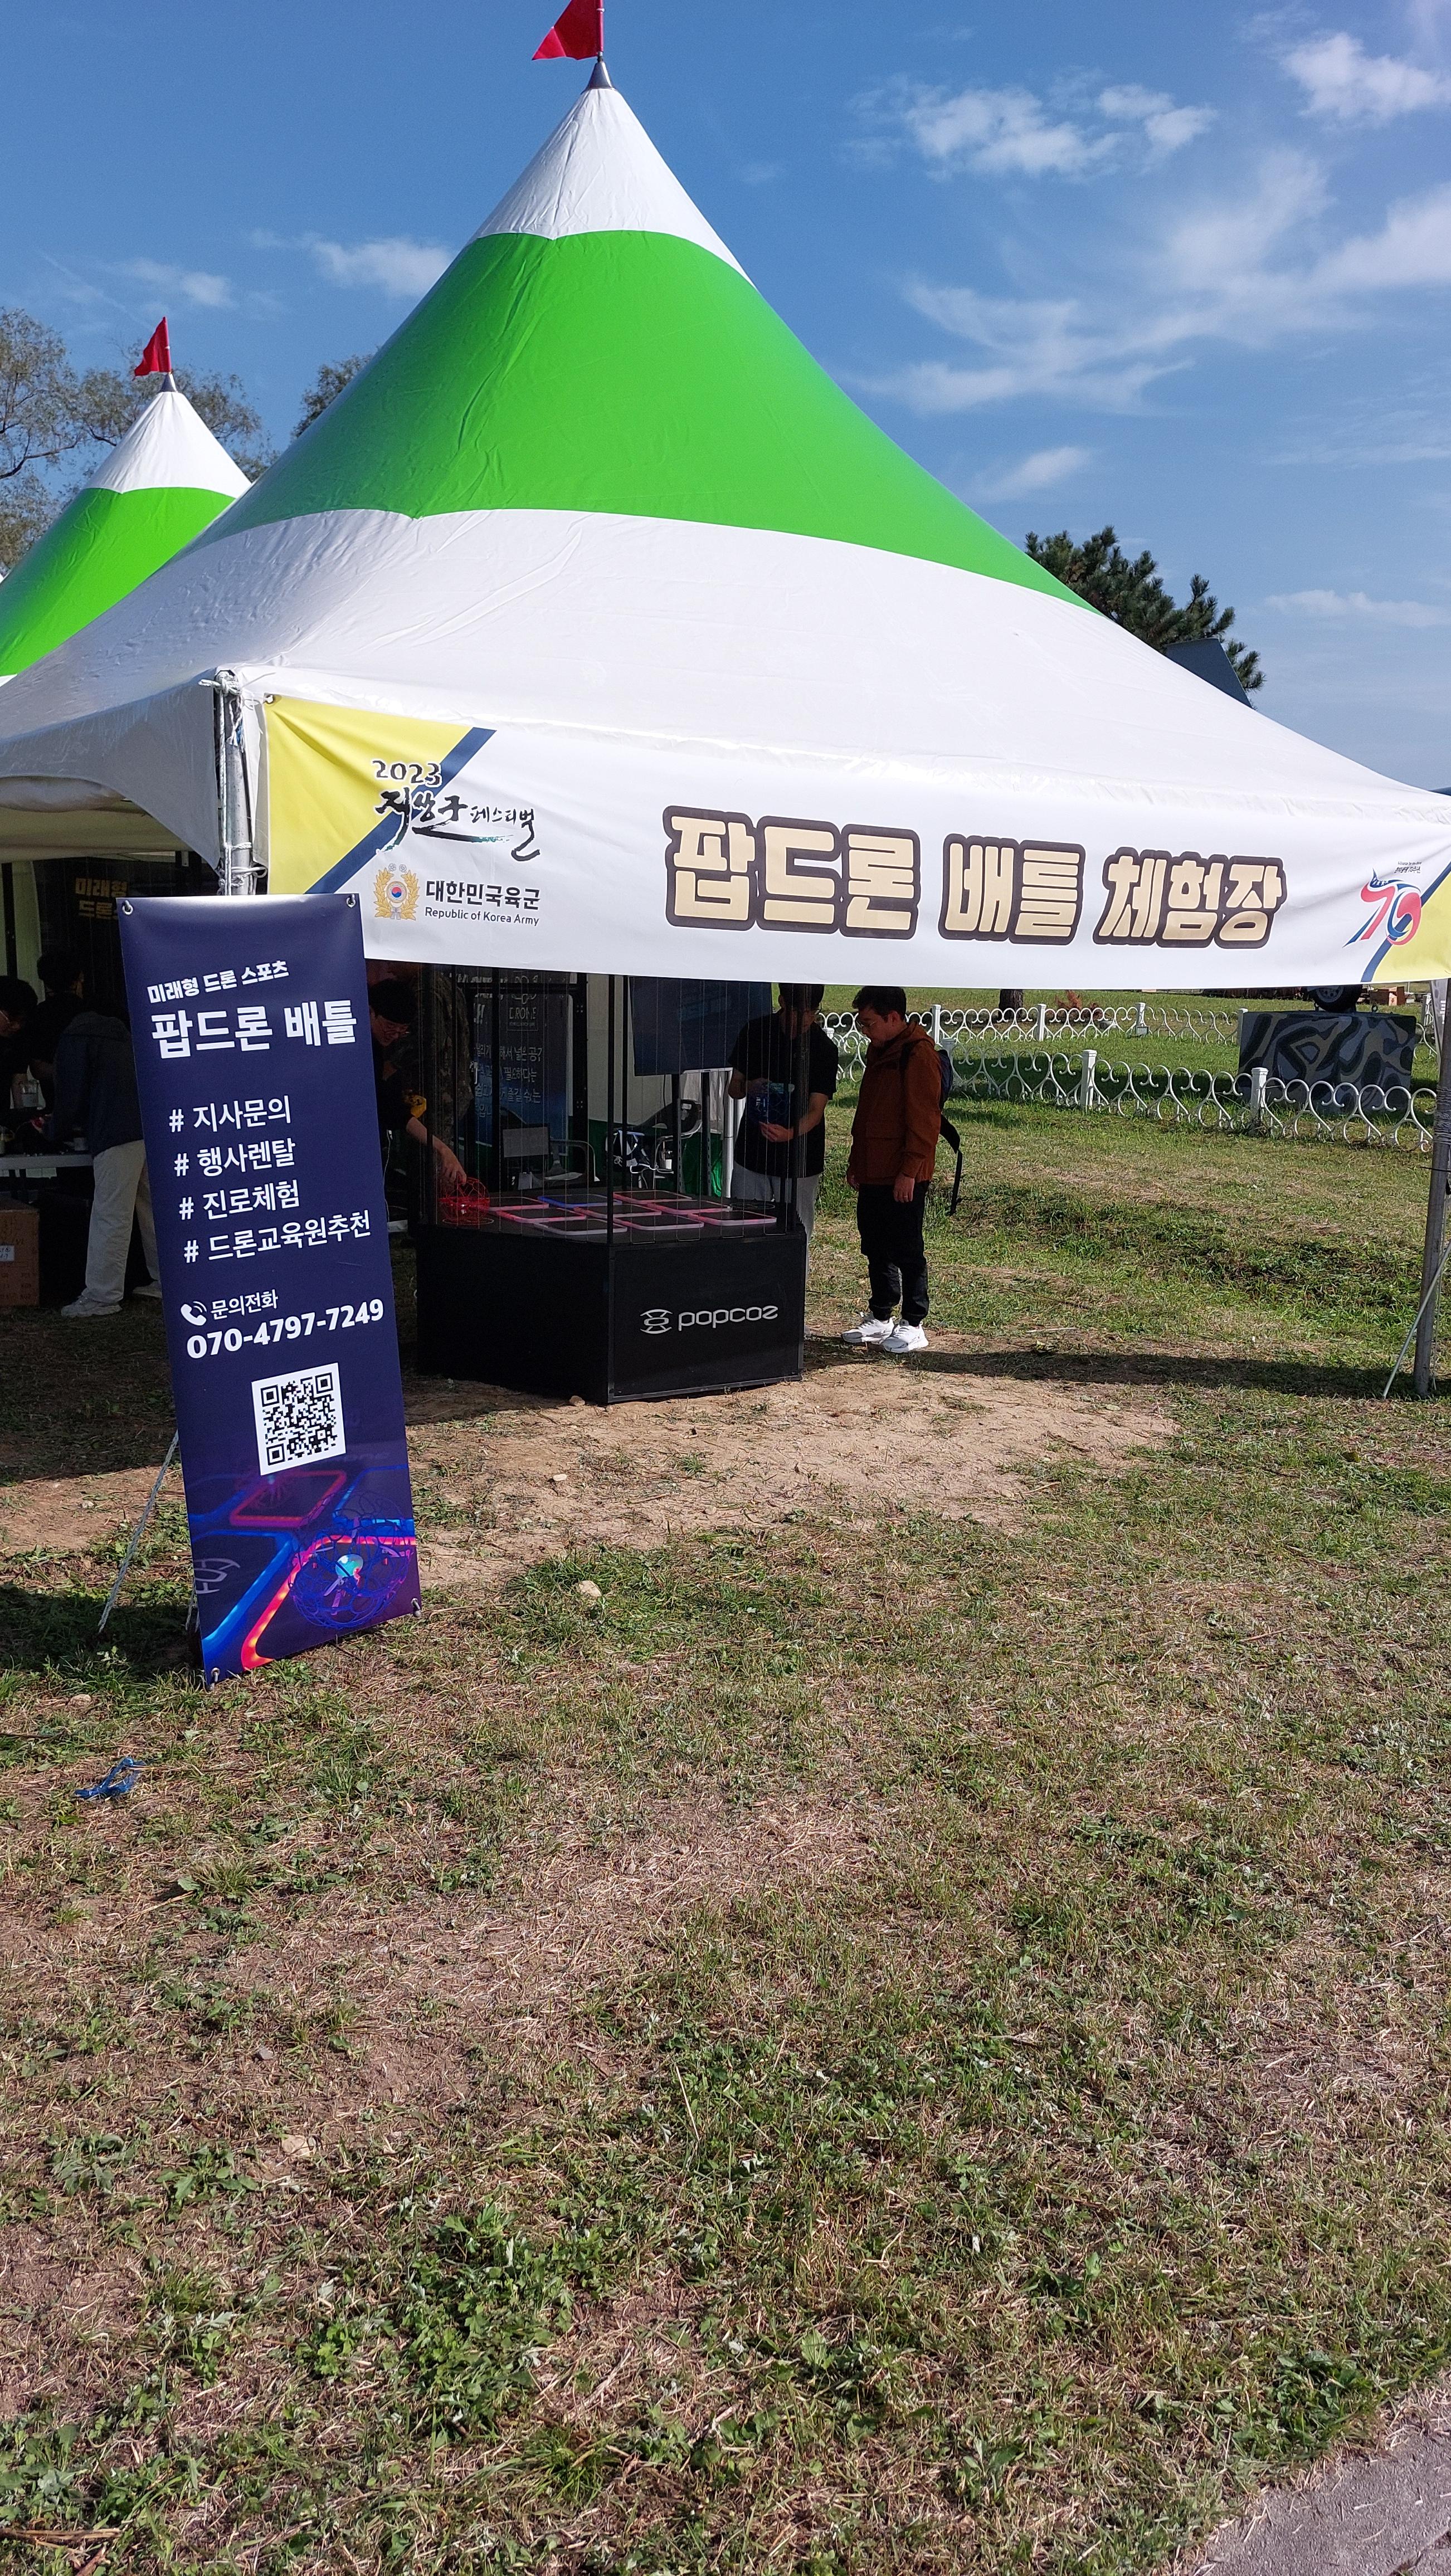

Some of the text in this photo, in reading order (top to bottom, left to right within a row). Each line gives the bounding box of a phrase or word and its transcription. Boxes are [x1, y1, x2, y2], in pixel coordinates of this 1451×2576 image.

[372, 760, 440, 786] 2023
[374, 787, 541, 861] 지상군 페스티벌
[75, 876, 128, 897] 미래형
[426, 880, 541, 911] 대한민국육군
[663, 806, 1287, 949] 팝드론 배틀 체험장
[425, 906, 539, 926] Republic of Korea Army
[147, 960, 289, 1003] 미래형 드론 스포츠
[151, 1000, 358, 1059] 팝드론 배틀
[169, 1095, 291, 1133] # 지사문의
[174, 1138, 296, 1177] # 행사렌탈
[179, 1179, 300, 1220] # 진로체험
[184, 1209, 371, 1263] # 드론교육원추천
[211, 1289, 279, 1320] 문의전화
[187, 1299, 383, 1359] 070-4797-7249
